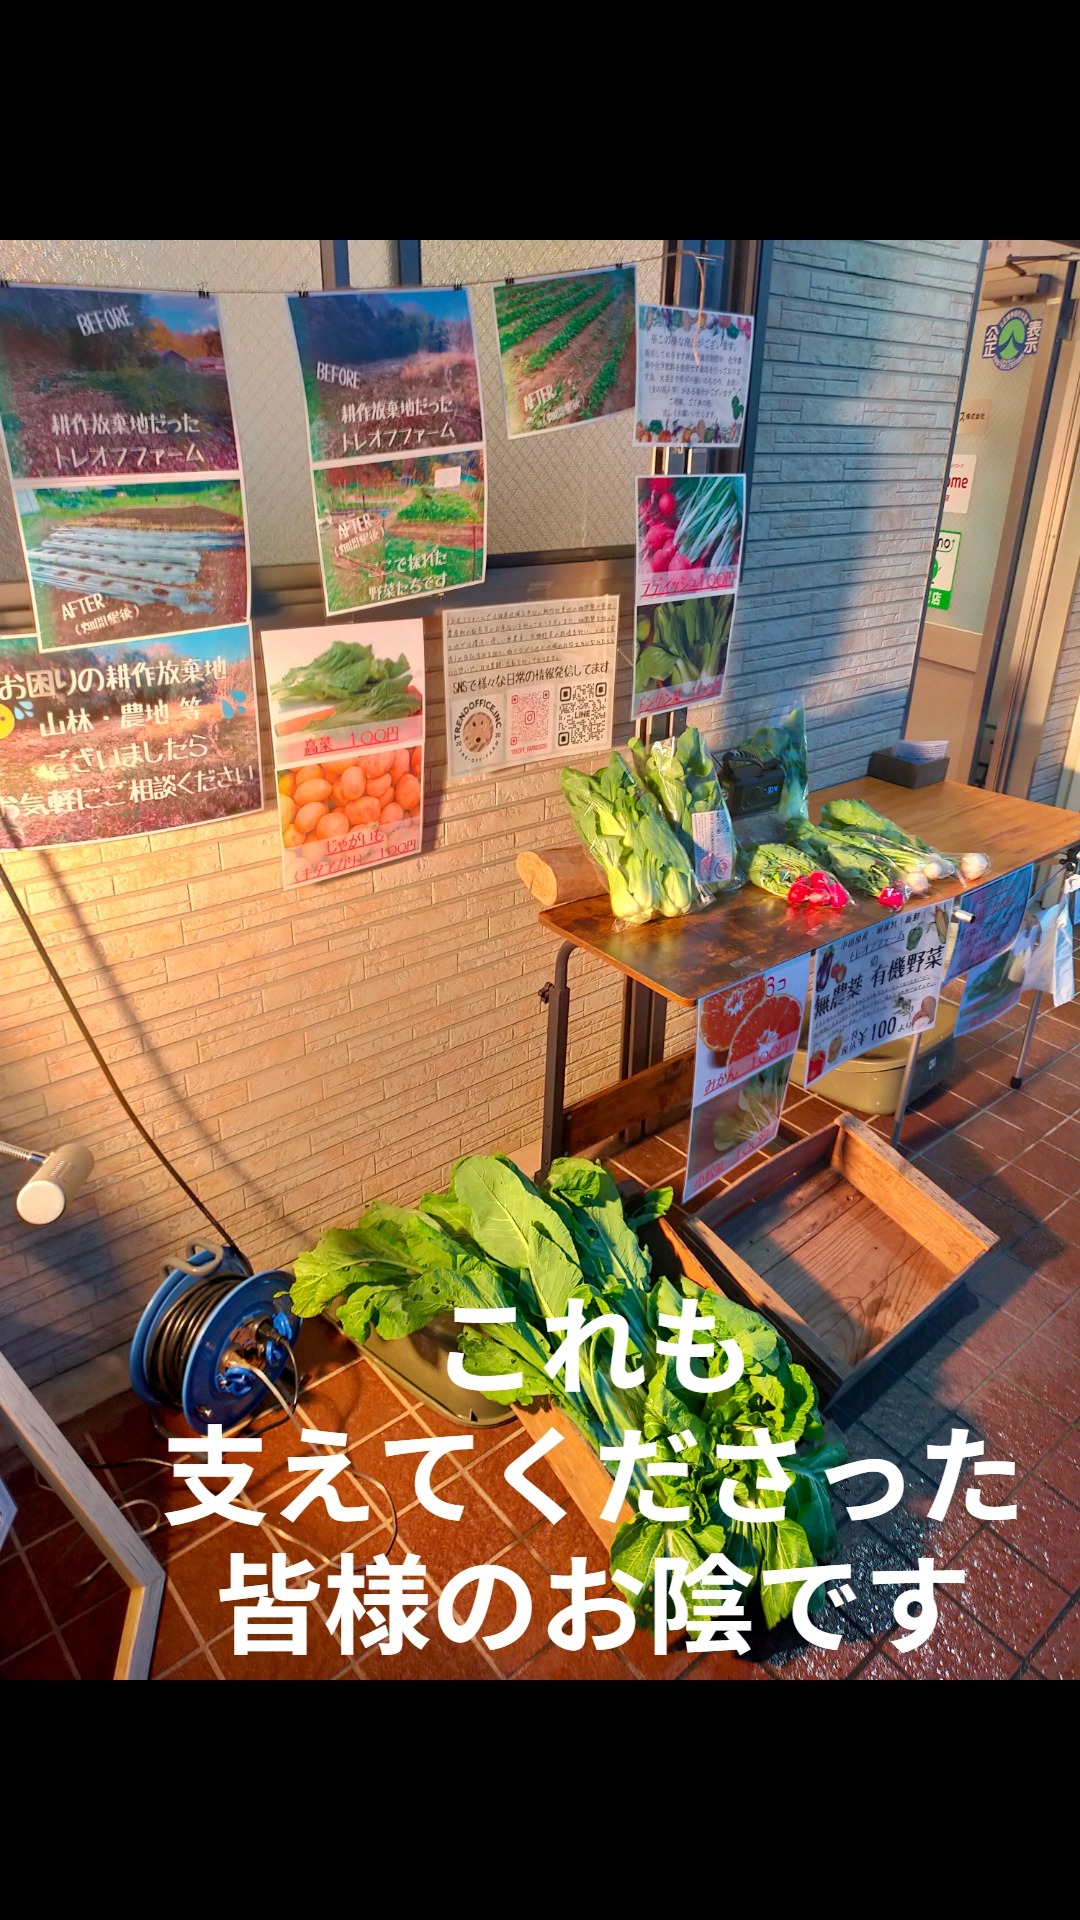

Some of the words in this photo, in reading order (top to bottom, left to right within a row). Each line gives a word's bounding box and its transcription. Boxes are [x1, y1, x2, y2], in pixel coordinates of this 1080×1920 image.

[77, 305, 135, 337] BEFORE
[982, 326, 999, 358] 公正
[1024, 319, 1042, 354] 表示
[316, 360, 361, 389] BEFORE
[341, 395, 453, 424] 耕作放棄地だった
[523, 384, 556, 412] AFTER
[52, 412, 201, 436] 耕作放棄地だった
[342, 422, 456, 452] トレオフファーム
[55, 443, 205, 469] トレオフファーム
[338, 513, 373, 540] AFTER
[368, 571, 447, 600] 野菜たちです
[928, 590, 943, 606] 店
[61, 593, 106, 621] AFTER
[0, 655, 227, 700] お困りの耕作放棄地
[452, 660, 610, 695] SNSで様々な日常の情報発信してます
[39, 699, 170, 738] 山林・農地
[180, 696, 203, 721] 等
[574, 709, 591, 719] LINE
[304, 736, 333, 754] 高菜
[350, 726, 399, 748] 100円
[44, 734, 209, 783] ございましたら
[0, 764, 254, 820] お気軽にご相談ください
[326, 828, 385, 854] じゃがいも
[380, 839, 417, 859] 100円
[813, 973, 865, 1019] 無農薬
[870, 945, 945, 989] 有機野菜
[858, 1016, 897, 1047] ¥100
[704, 1069, 738, 1094] みかん
[750, 1039, 789, 1071] 100円
